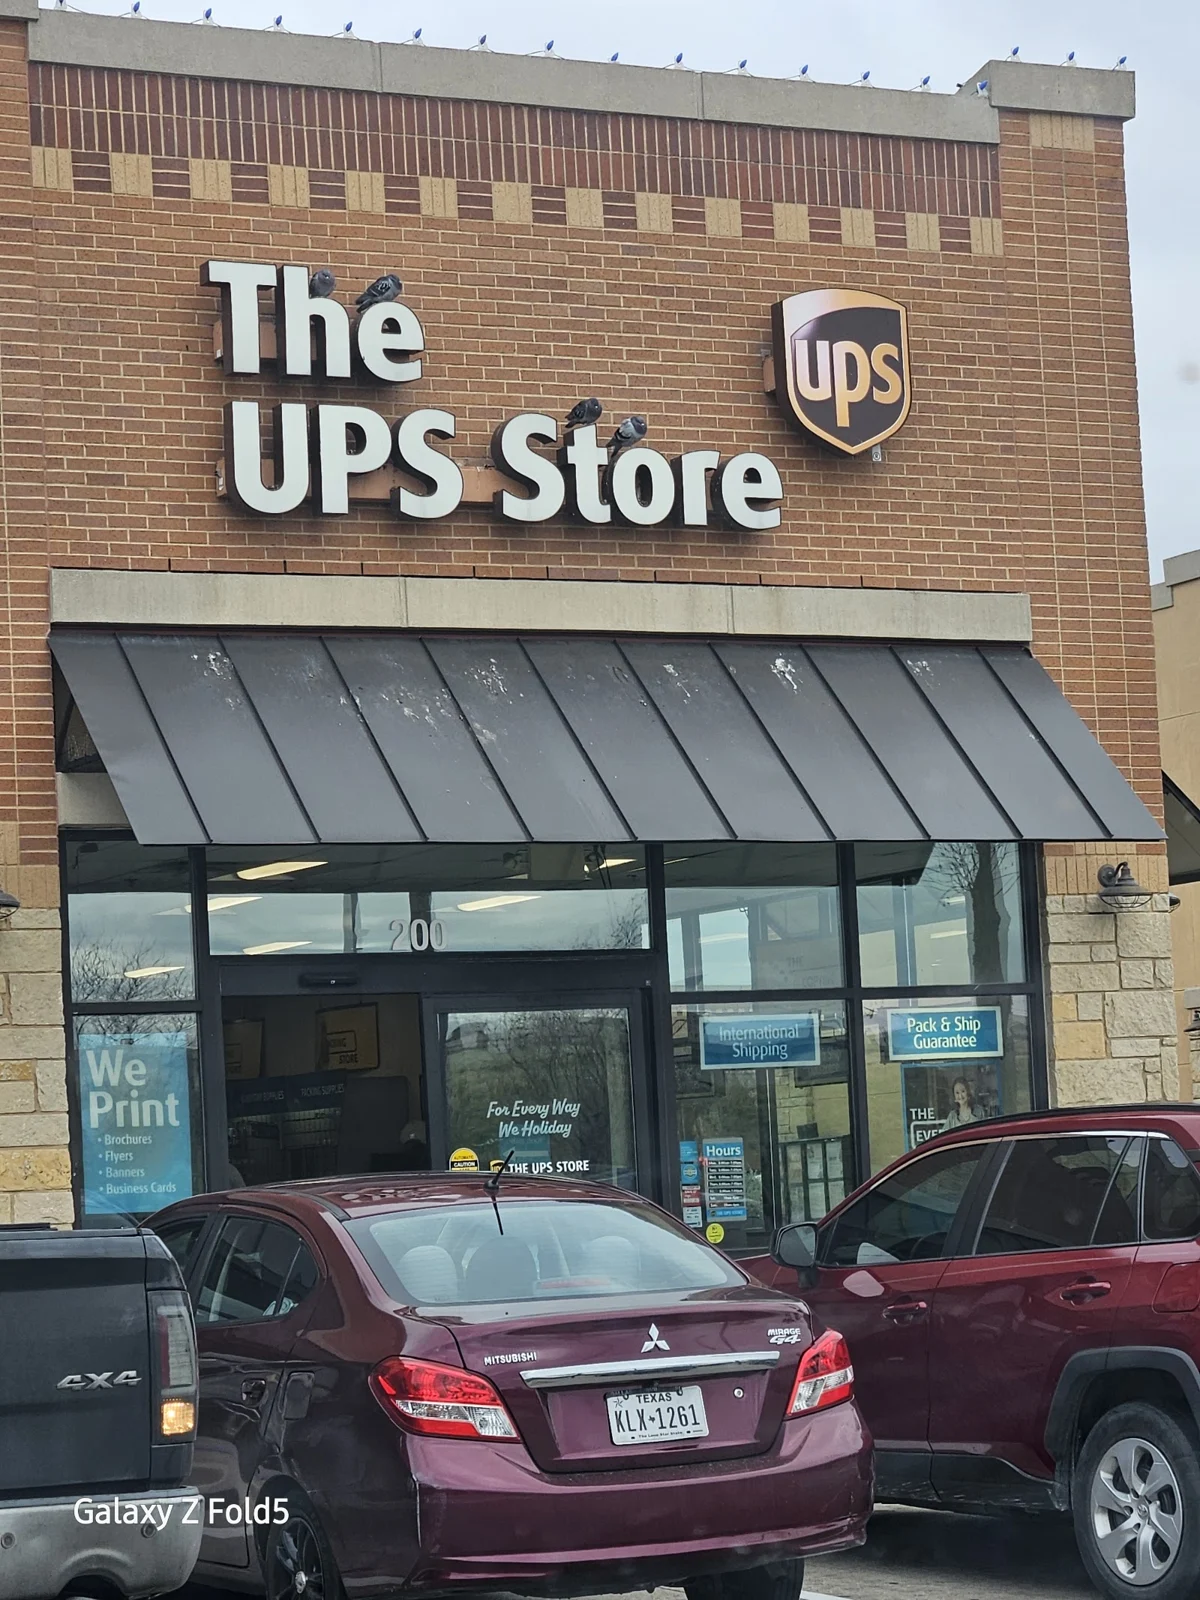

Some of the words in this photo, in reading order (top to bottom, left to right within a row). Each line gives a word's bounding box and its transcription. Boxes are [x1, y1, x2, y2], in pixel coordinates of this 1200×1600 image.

[207, 260, 425, 382] The
[794, 340, 902, 428] ups
[231, 402, 465, 520] UPS
[499, 412, 784, 531] Store
[388, 918, 448, 951] 200
[719, 1023, 799, 1041] International
[907, 1017, 937, 1033] Pack
[940, 1017, 952, 1031] &
[954, 1016, 981, 1034] Ship
[913, 1034, 977, 1050] Guarantee
[732, 1042, 788, 1061] Shipping
[86, 1049, 147, 1087] We
[89, 1089, 180, 1129] Print
[487, 1101, 510, 1118] For
[511, 1100, 549, 1119] Every
[552, 1098, 580, 1117] Way
[909, 1107, 936, 1120] THE
[498, 1120, 520, 1138] We
[521, 1120, 572, 1138] Holiday
[104, 1134, 152, 1145] Brochures
[105, 1151, 134, 1164] Flyers
[706, 1145, 741, 1157] Hours
[106, 1167, 145, 1178] Banners
[508, 1163, 529, 1174] THE
[532, 1162, 553, 1174] UPS
[556, 1160, 590, 1173] STORE
[106, 1183, 148, 1195] Business
[150, 1181, 177, 1193] Cards
[767, 1328, 801, 1337] MIRAGE
[769, 1335, 802, 1345] G4
[484, 1351, 537, 1366] MITSUBISHI
[636, 1392, 672, 1404] TEXAS
